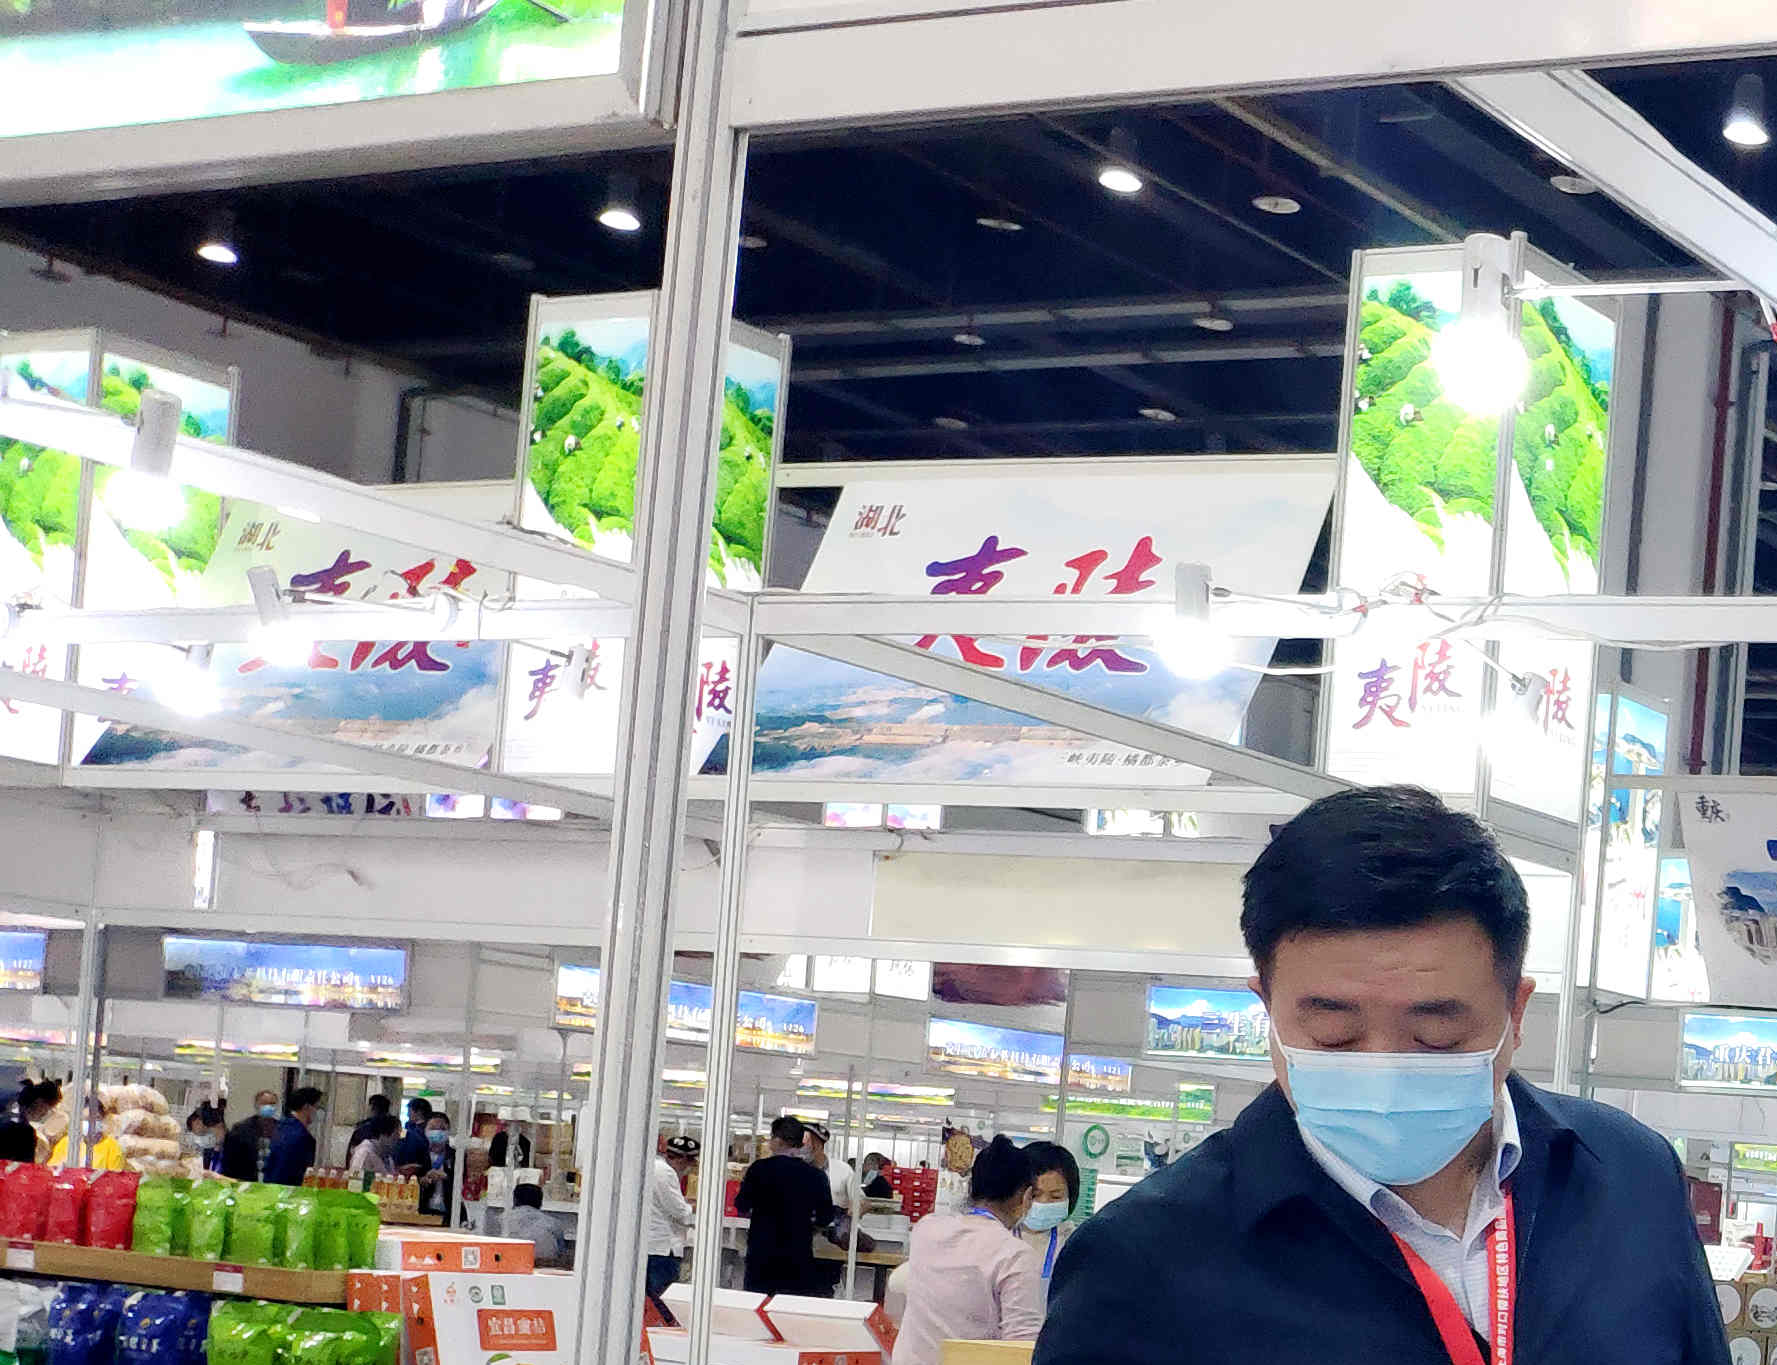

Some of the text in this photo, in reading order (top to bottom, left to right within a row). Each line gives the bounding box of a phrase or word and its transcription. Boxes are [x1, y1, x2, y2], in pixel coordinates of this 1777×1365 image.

[856, 504, 907, 538] 湖北
[1351, 638, 1463, 731] 夷陵
[486, 1315, 547, 1337] 宜昌蜜桔
